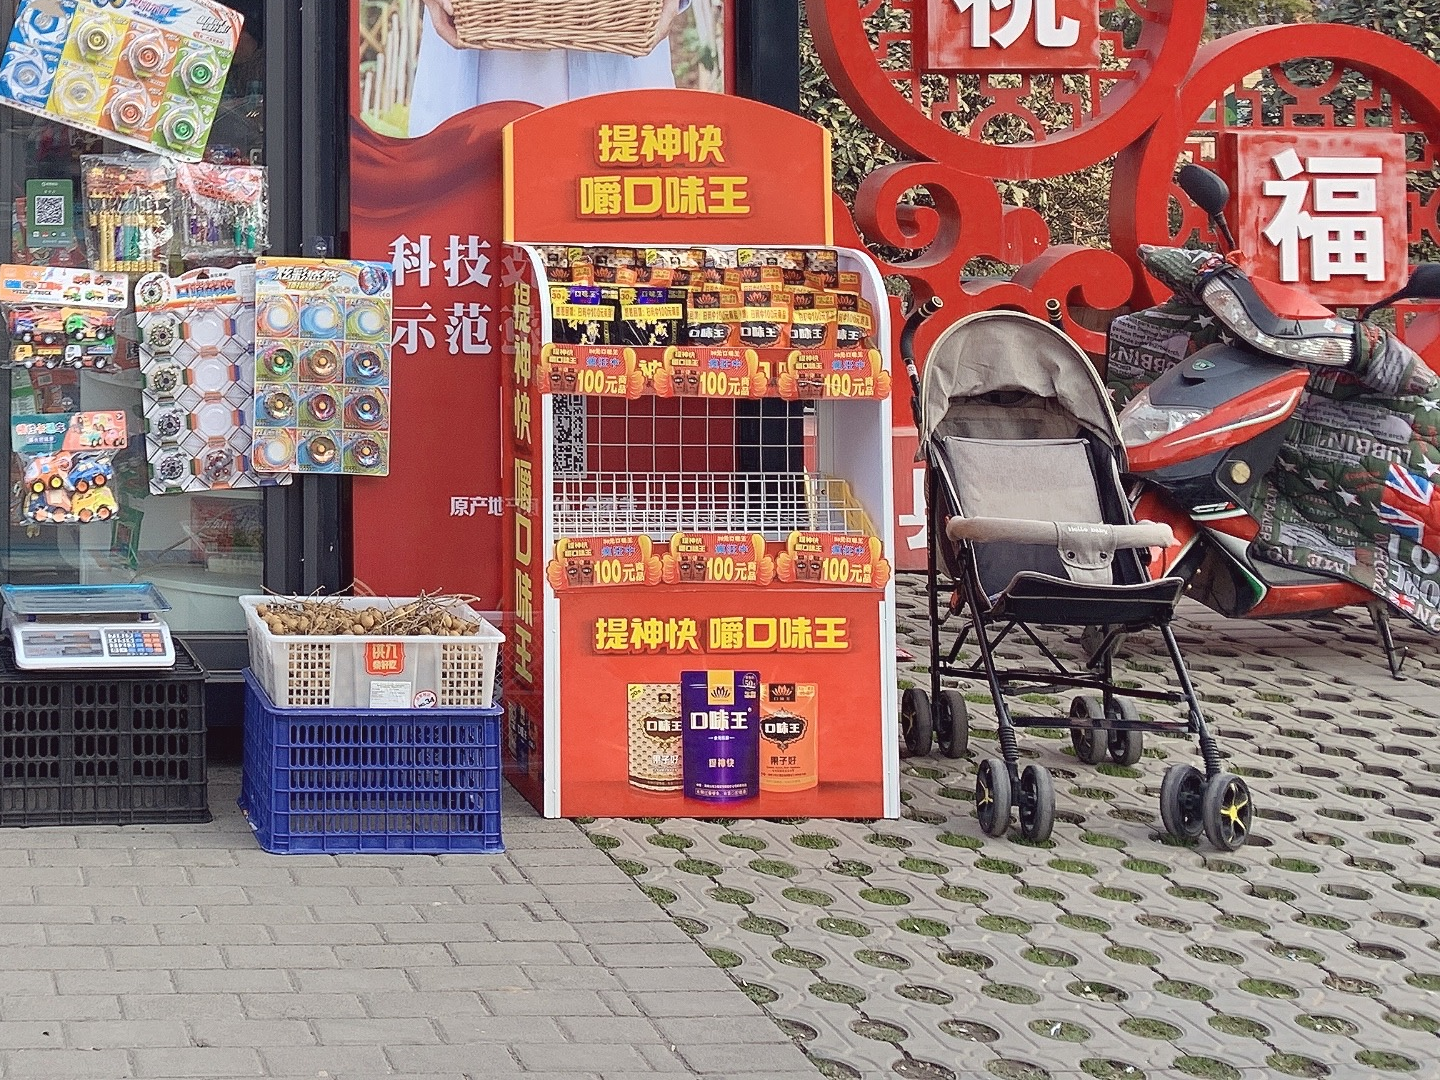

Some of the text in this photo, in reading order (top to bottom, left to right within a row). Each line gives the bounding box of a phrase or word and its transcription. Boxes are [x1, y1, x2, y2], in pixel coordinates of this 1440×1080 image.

[598, 124, 725, 163] 提神快
[580, 176, 750, 215] 嚼口味王
[1263, 148, 1386, 282] 福
[389, 234, 492, 288] 科技
[389, 302, 492, 354] 示范
[740, 326, 777, 338] 口味王
[578, 370, 617, 393] 100元
[700, 371, 740, 395] 100元
[824, 373, 864, 397] 100元
[450, 496, 504, 517] 原产地
[594, 559, 635, 584] 100元
[707, 556, 747, 581] 100元
[823, 557, 863, 583] 100元
[595, 617, 850, 651] 提神快 嚼口味王
[690, 708, 749, 731] 口味王
[764, 722, 800, 734] 口味王
[709, 757, 735, 768] 提神快
[770, 756, 797, 766] 果子好
